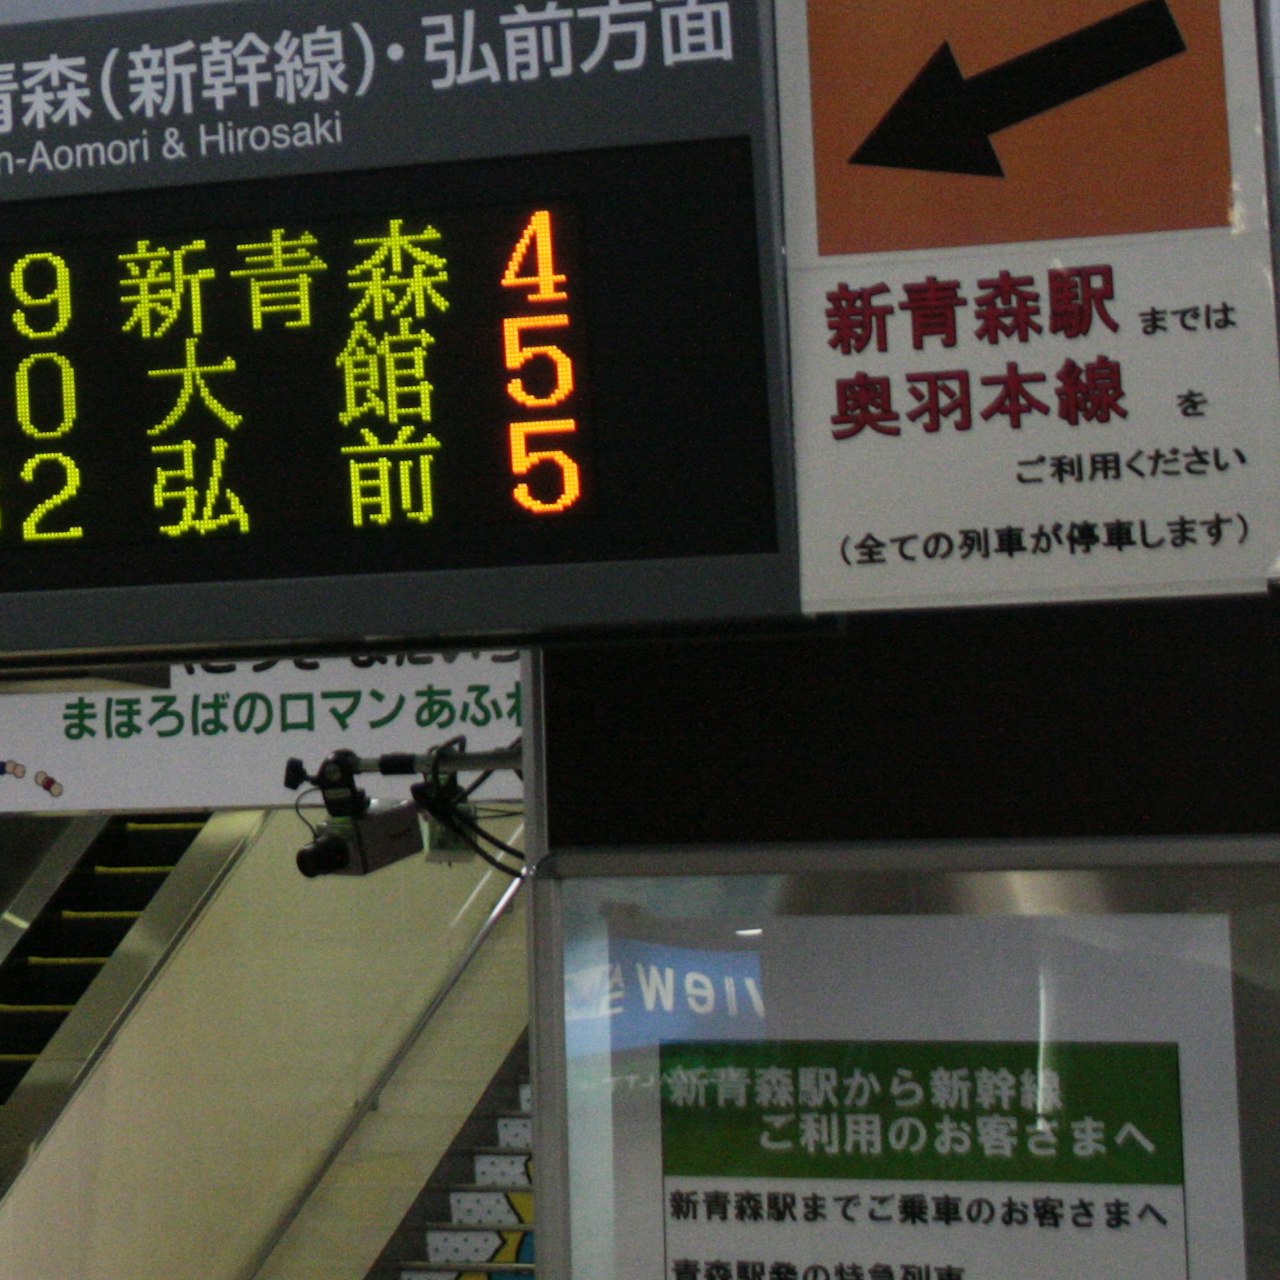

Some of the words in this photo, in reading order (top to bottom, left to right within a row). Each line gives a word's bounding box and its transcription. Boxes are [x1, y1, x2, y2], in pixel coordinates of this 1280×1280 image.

[162, 125, 188, 160] &
[198, 111, 343, 157] Hirosaki
[120, 218, 450, 339] 新青森
[500, 209, 569, 304] 4
[825, 264, 1119, 355] 新青森駅
[1139, 301, 1236, 335] までは
[146, 320, 433, 437] 大館
[501, 314, 575, 408] 5
[830, 354, 1128, 440] 奥羽本線
[1176, 389, 1209, 417] を
[152, 428, 442, 537] 弘前
[509, 418, 581, 514] 5
[1016, 446, 1248, 484] ご利用ください
[841, 513, 1249, 566] (全ての列車が停車します)
[669, 1065, 1064, 1113] 新青森駅から新幹線
[758, 1114, 1157, 1157] ご利用のお客さまへ
[669, 1189, 1169, 1230] 新青森駅までご乗車のお客さまへ
